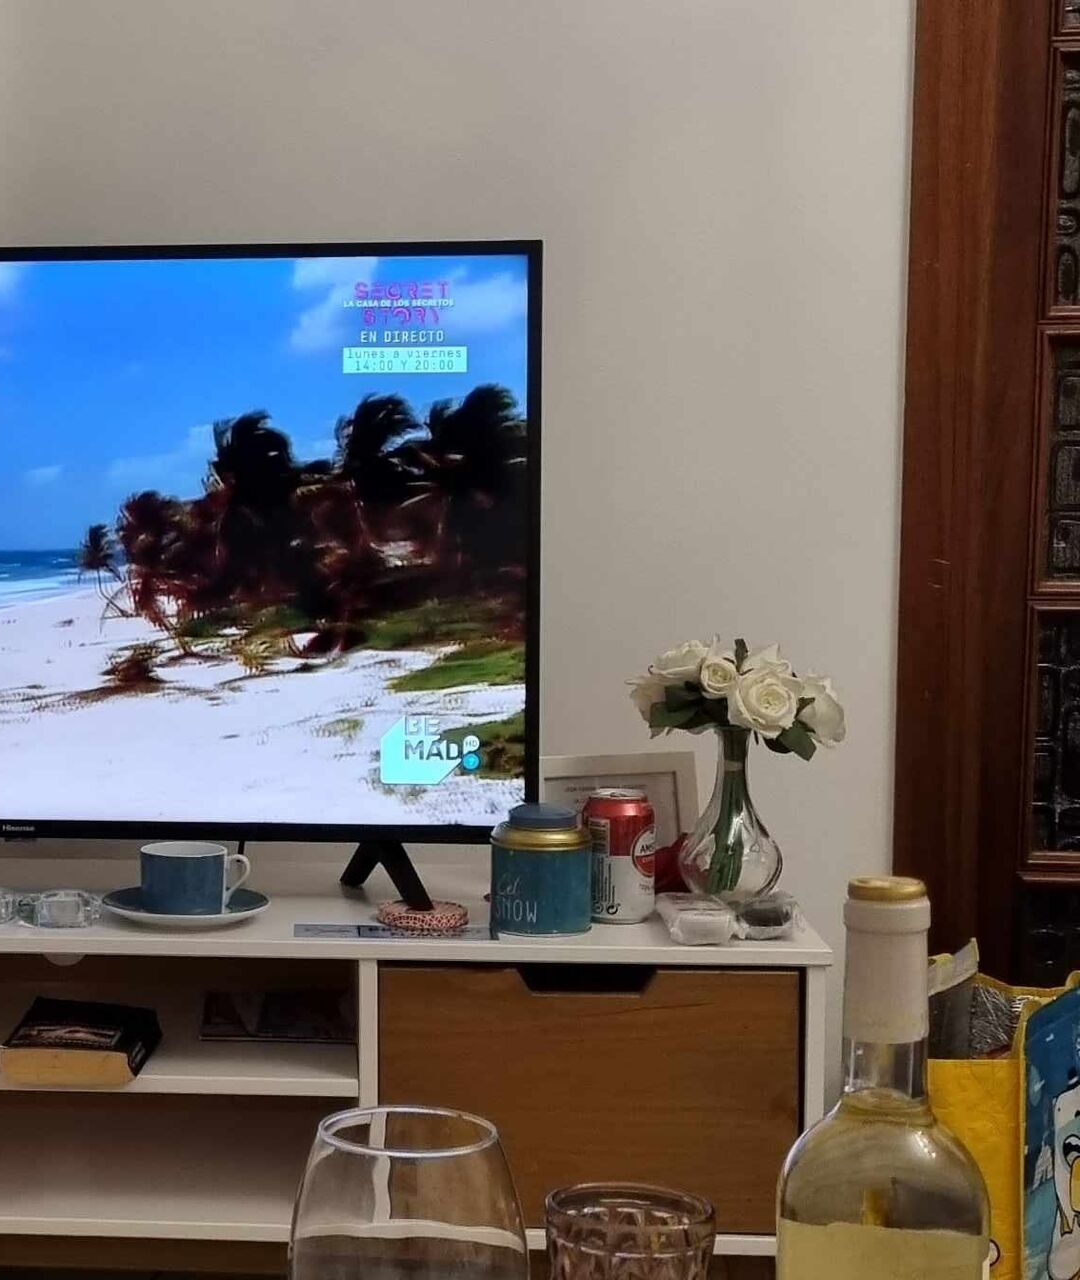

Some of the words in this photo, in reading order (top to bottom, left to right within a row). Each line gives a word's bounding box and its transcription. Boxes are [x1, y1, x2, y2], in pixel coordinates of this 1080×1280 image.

[354, 280, 451, 300] SECRET
[360, 330, 377, 344] EN
[383, 329, 445, 344] DIRECTO
[346, 349, 386, 360] lunes
[406, 348, 463, 359] viernes
[354, 360, 394, 372] 14:00
[414, 359, 454, 372] 20:00
[404, 716, 441, 736] BE
[403, 739, 461, 761] MAD
